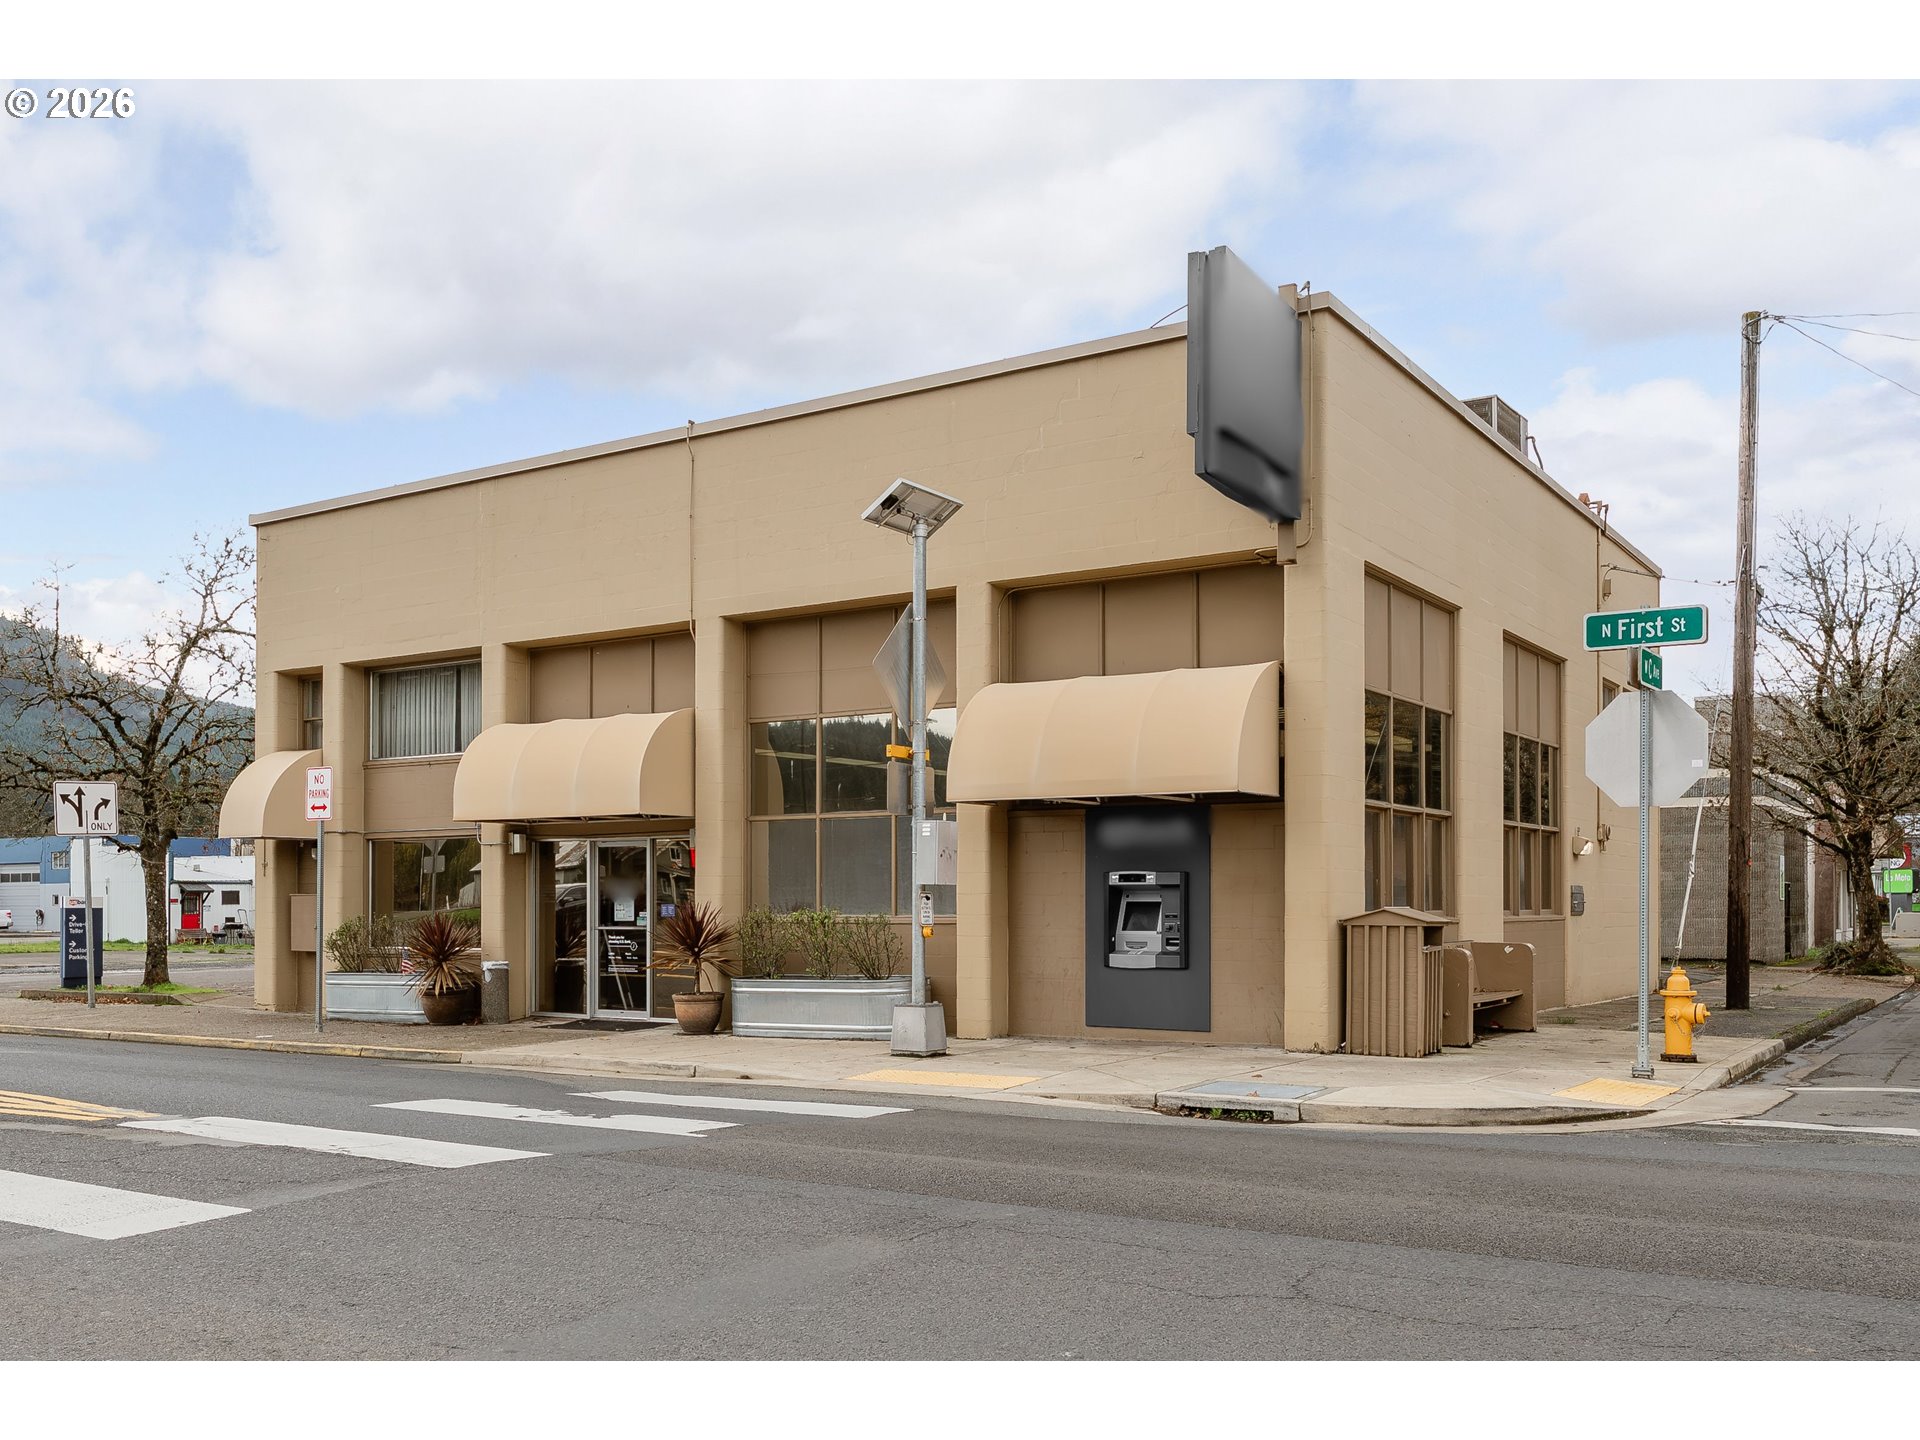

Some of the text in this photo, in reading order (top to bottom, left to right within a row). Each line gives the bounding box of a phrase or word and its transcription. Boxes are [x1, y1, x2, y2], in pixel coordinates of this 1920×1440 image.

[1602, 616, 1686, 640] N First St
[1648, 658, 1653, 680] C
[314, 774, 324, 784] NO
[309, 789, 329, 798] PARKING
[91, 822, 113, 831] ONLY
